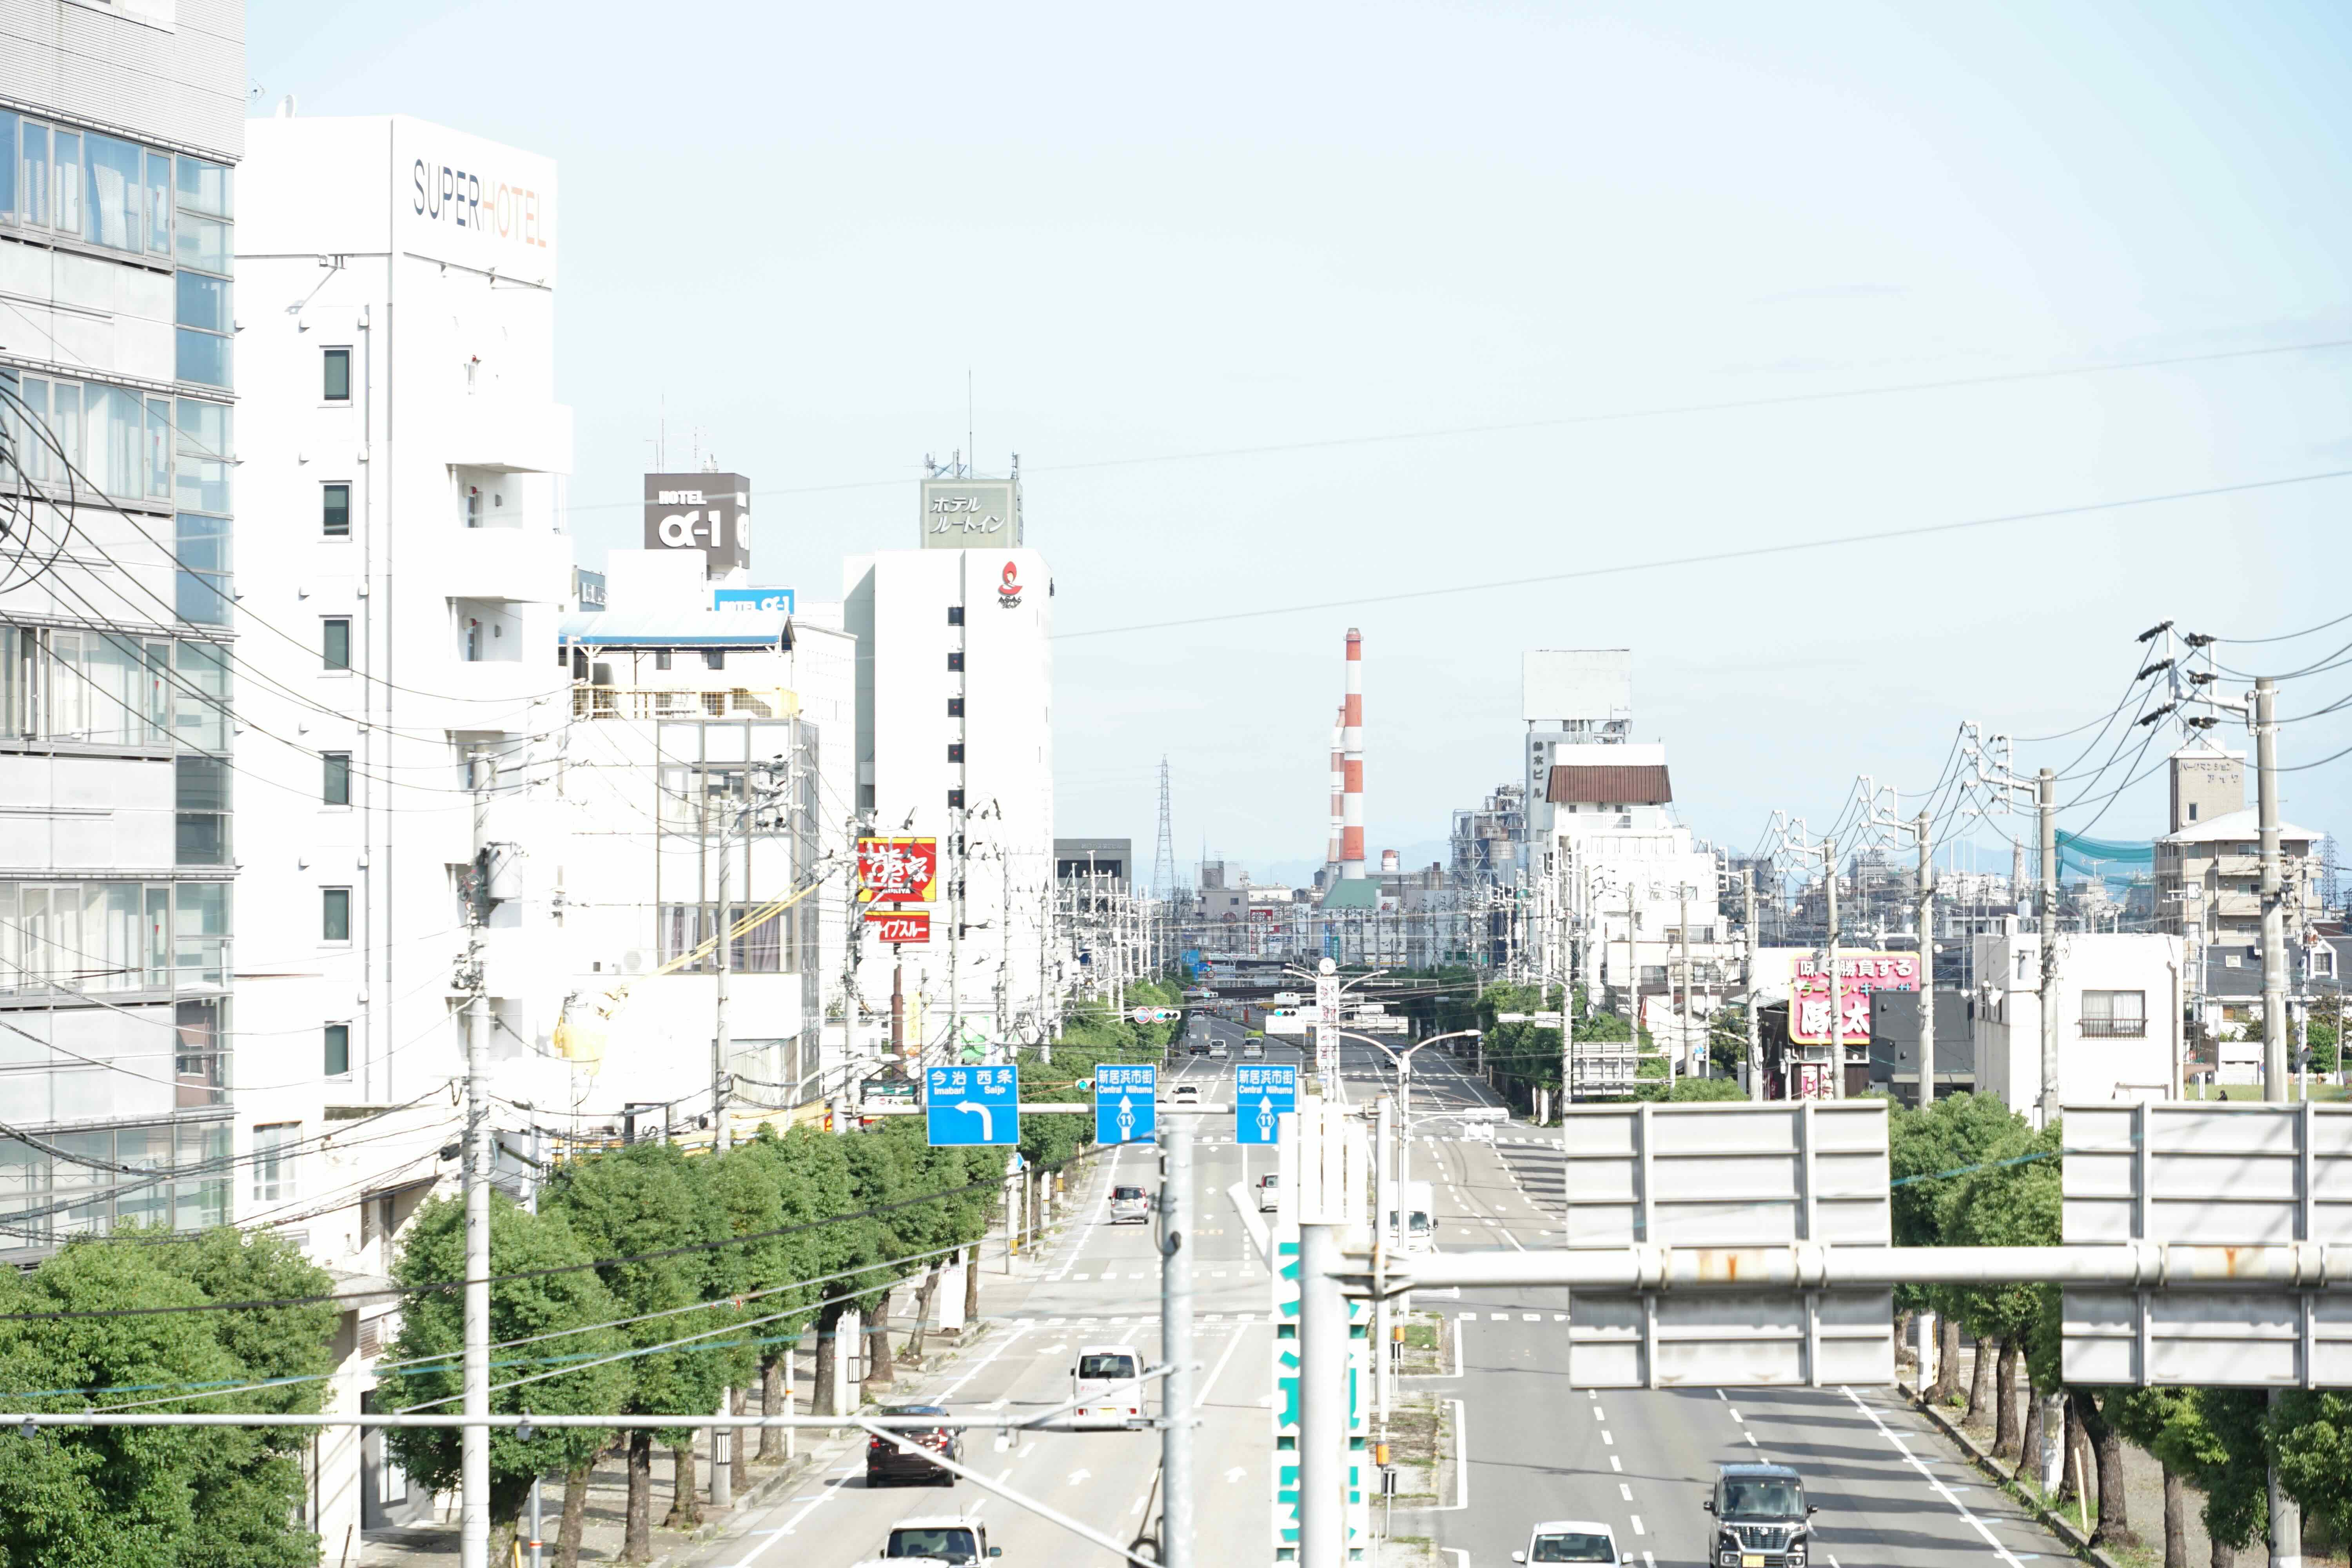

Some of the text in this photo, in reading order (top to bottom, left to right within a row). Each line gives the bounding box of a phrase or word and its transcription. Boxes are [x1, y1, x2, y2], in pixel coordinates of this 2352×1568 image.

[659, 490, 707, 505] HOTEL
[929, 497, 982, 513] ホテル
[929, 515, 1005, 534] ルートイン
[931, 1069, 1013, 1086] 今治 西条
[1098, 1070, 1153, 1085] 新居浜市街
[1239, 1070, 1293, 1085] 新居浜市街
[934, 1086, 1006, 1095] Imabari Saijo
[1098, 1085, 1153, 1094] Central Niihama
[1239, 1085, 1293, 1094] Central Niihama
[1120, 1115, 1131, 1125] 11
[1260, 1115, 1272, 1126] 11
